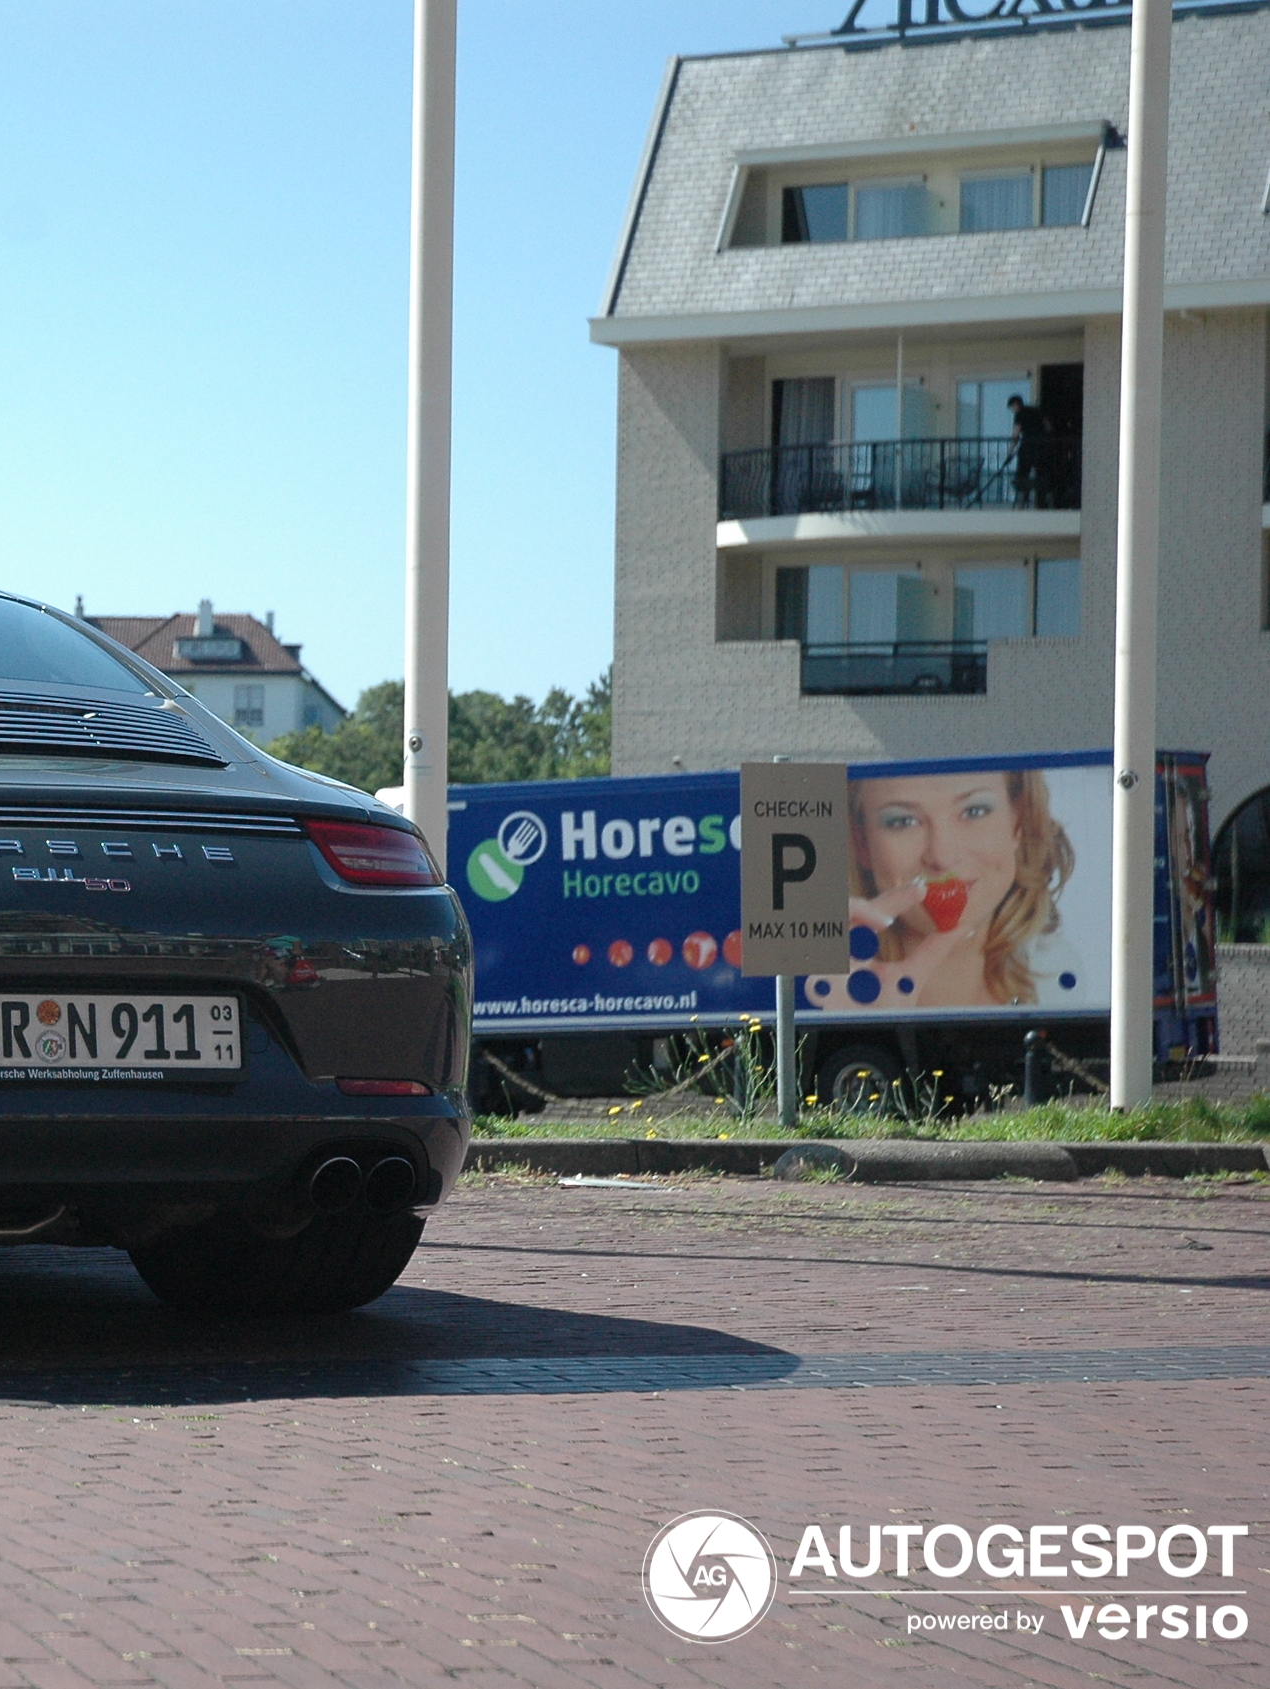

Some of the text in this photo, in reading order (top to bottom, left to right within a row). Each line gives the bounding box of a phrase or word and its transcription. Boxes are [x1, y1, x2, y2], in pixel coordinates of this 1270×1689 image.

[754, 801, 832, 818] CHECK-IN
[12, 867, 75, 881] 911
[772, 833, 817, 910] P
[563, 869, 700, 898] Horecavo
[749, 922, 843, 939] MAX 10 MIN
[473, 990, 697, 1015] www.horesca-horecavo.nl
[211, 1005, 232, 1021] 03
[67, 1002, 98, 1059] N
[111, 1002, 201, 1060] 911
[214, 1044, 234, 1061] 11
[28, 1068, 100, 1081] Werksabholung
[102, 1069, 164, 1079] Zuffenhausen
